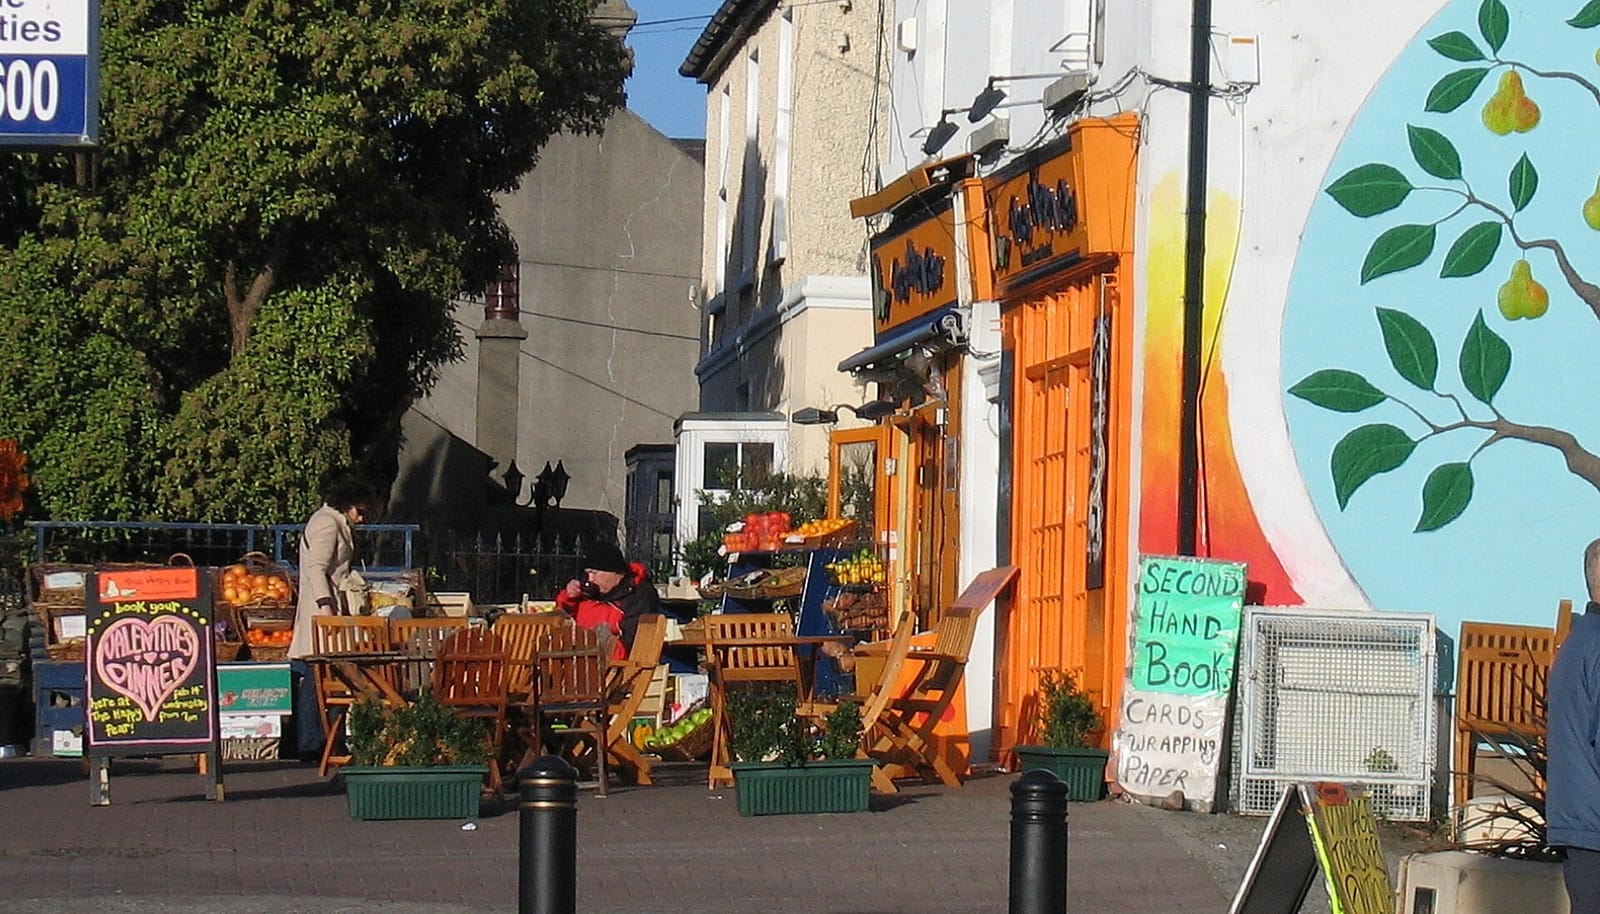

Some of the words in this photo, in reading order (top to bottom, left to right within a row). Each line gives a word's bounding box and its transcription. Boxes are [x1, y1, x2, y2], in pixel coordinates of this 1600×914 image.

[0, 59, 59, 122] 00
[1143, 562, 1240, 597] SECOND
[114, 601, 147, 614] book
[149, 601, 181, 615] your
[1150, 601, 1222, 641] HAND
[105, 657, 187, 707] DINNER
[89, 697, 116, 710] here
[117, 696, 131, 706] at
[1126, 699, 1205, 729] CARDS
[1124, 756, 1189, 790] PAPER
